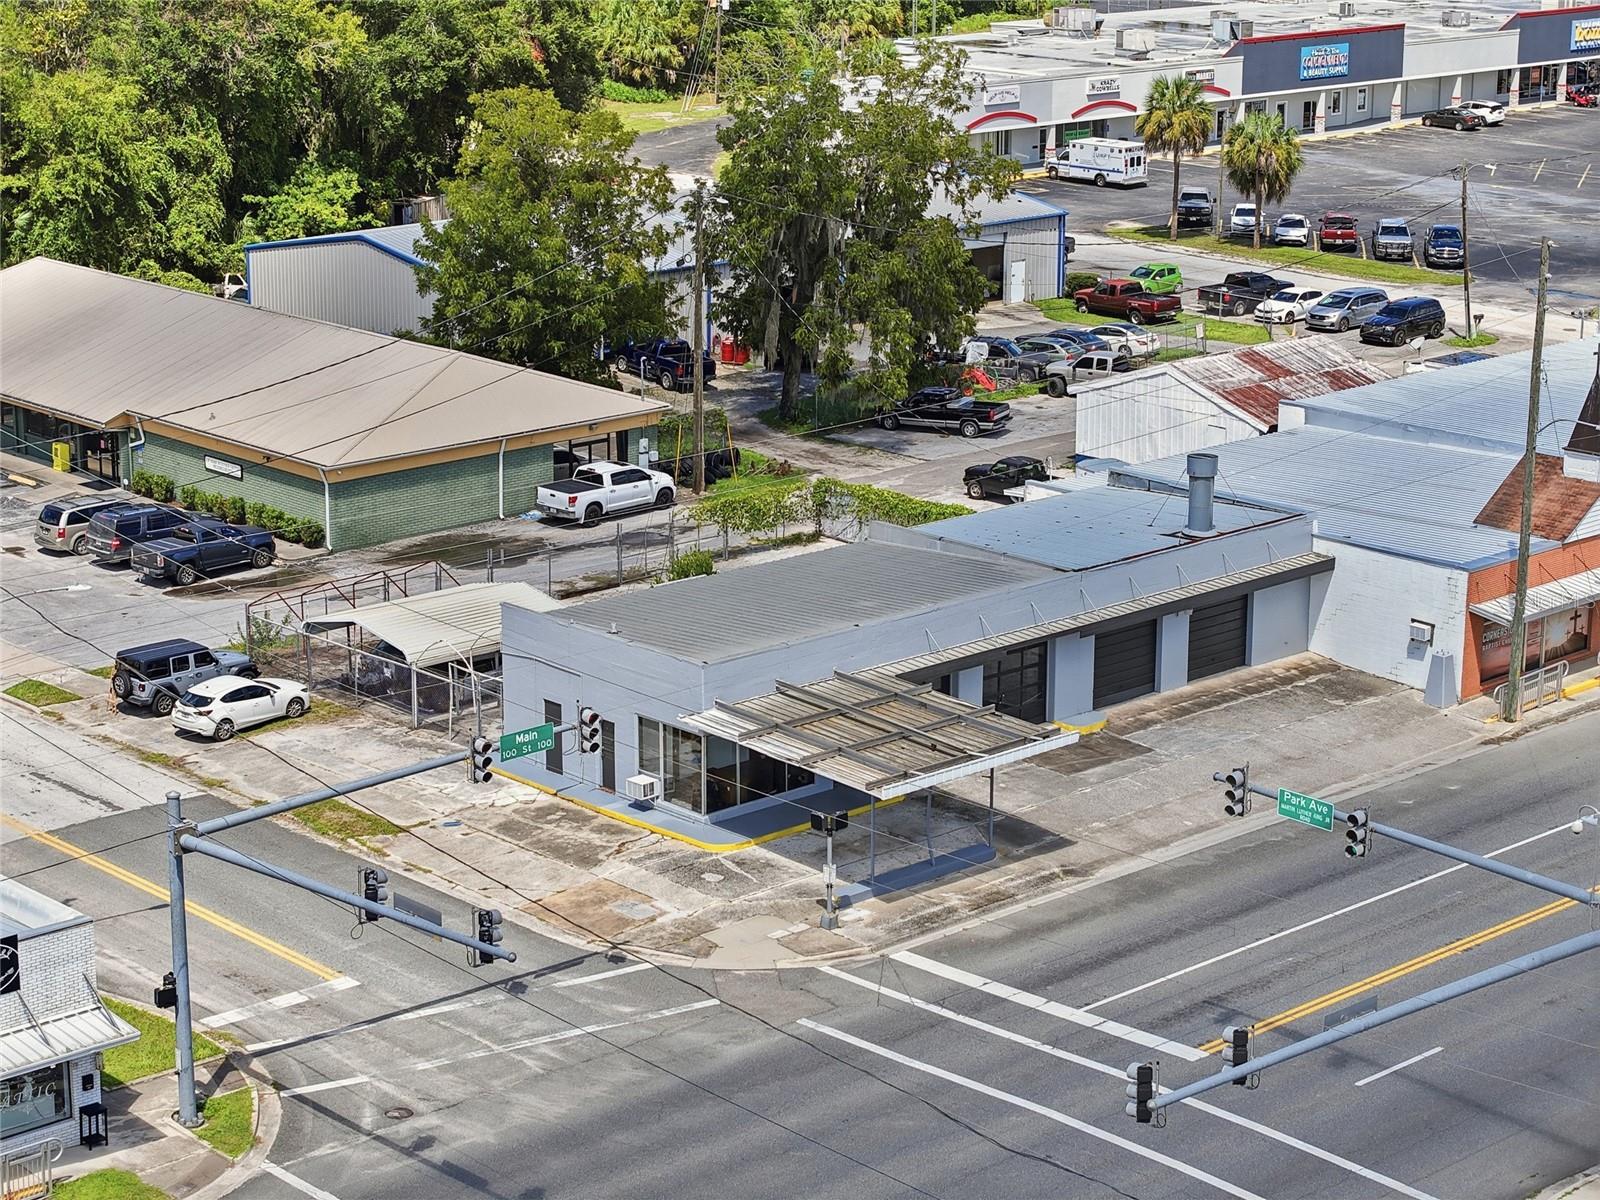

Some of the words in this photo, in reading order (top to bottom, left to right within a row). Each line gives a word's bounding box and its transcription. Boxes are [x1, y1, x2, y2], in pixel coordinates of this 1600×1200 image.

[515, 731, 538, 744] Main
[502, 749, 517, 758] 100
[522, 744, 532, 753] St
[537, 739, 552, 749] 100
[1284, 791, 1306, 808] Park
[1309, 799, 1328, 814] Ave
